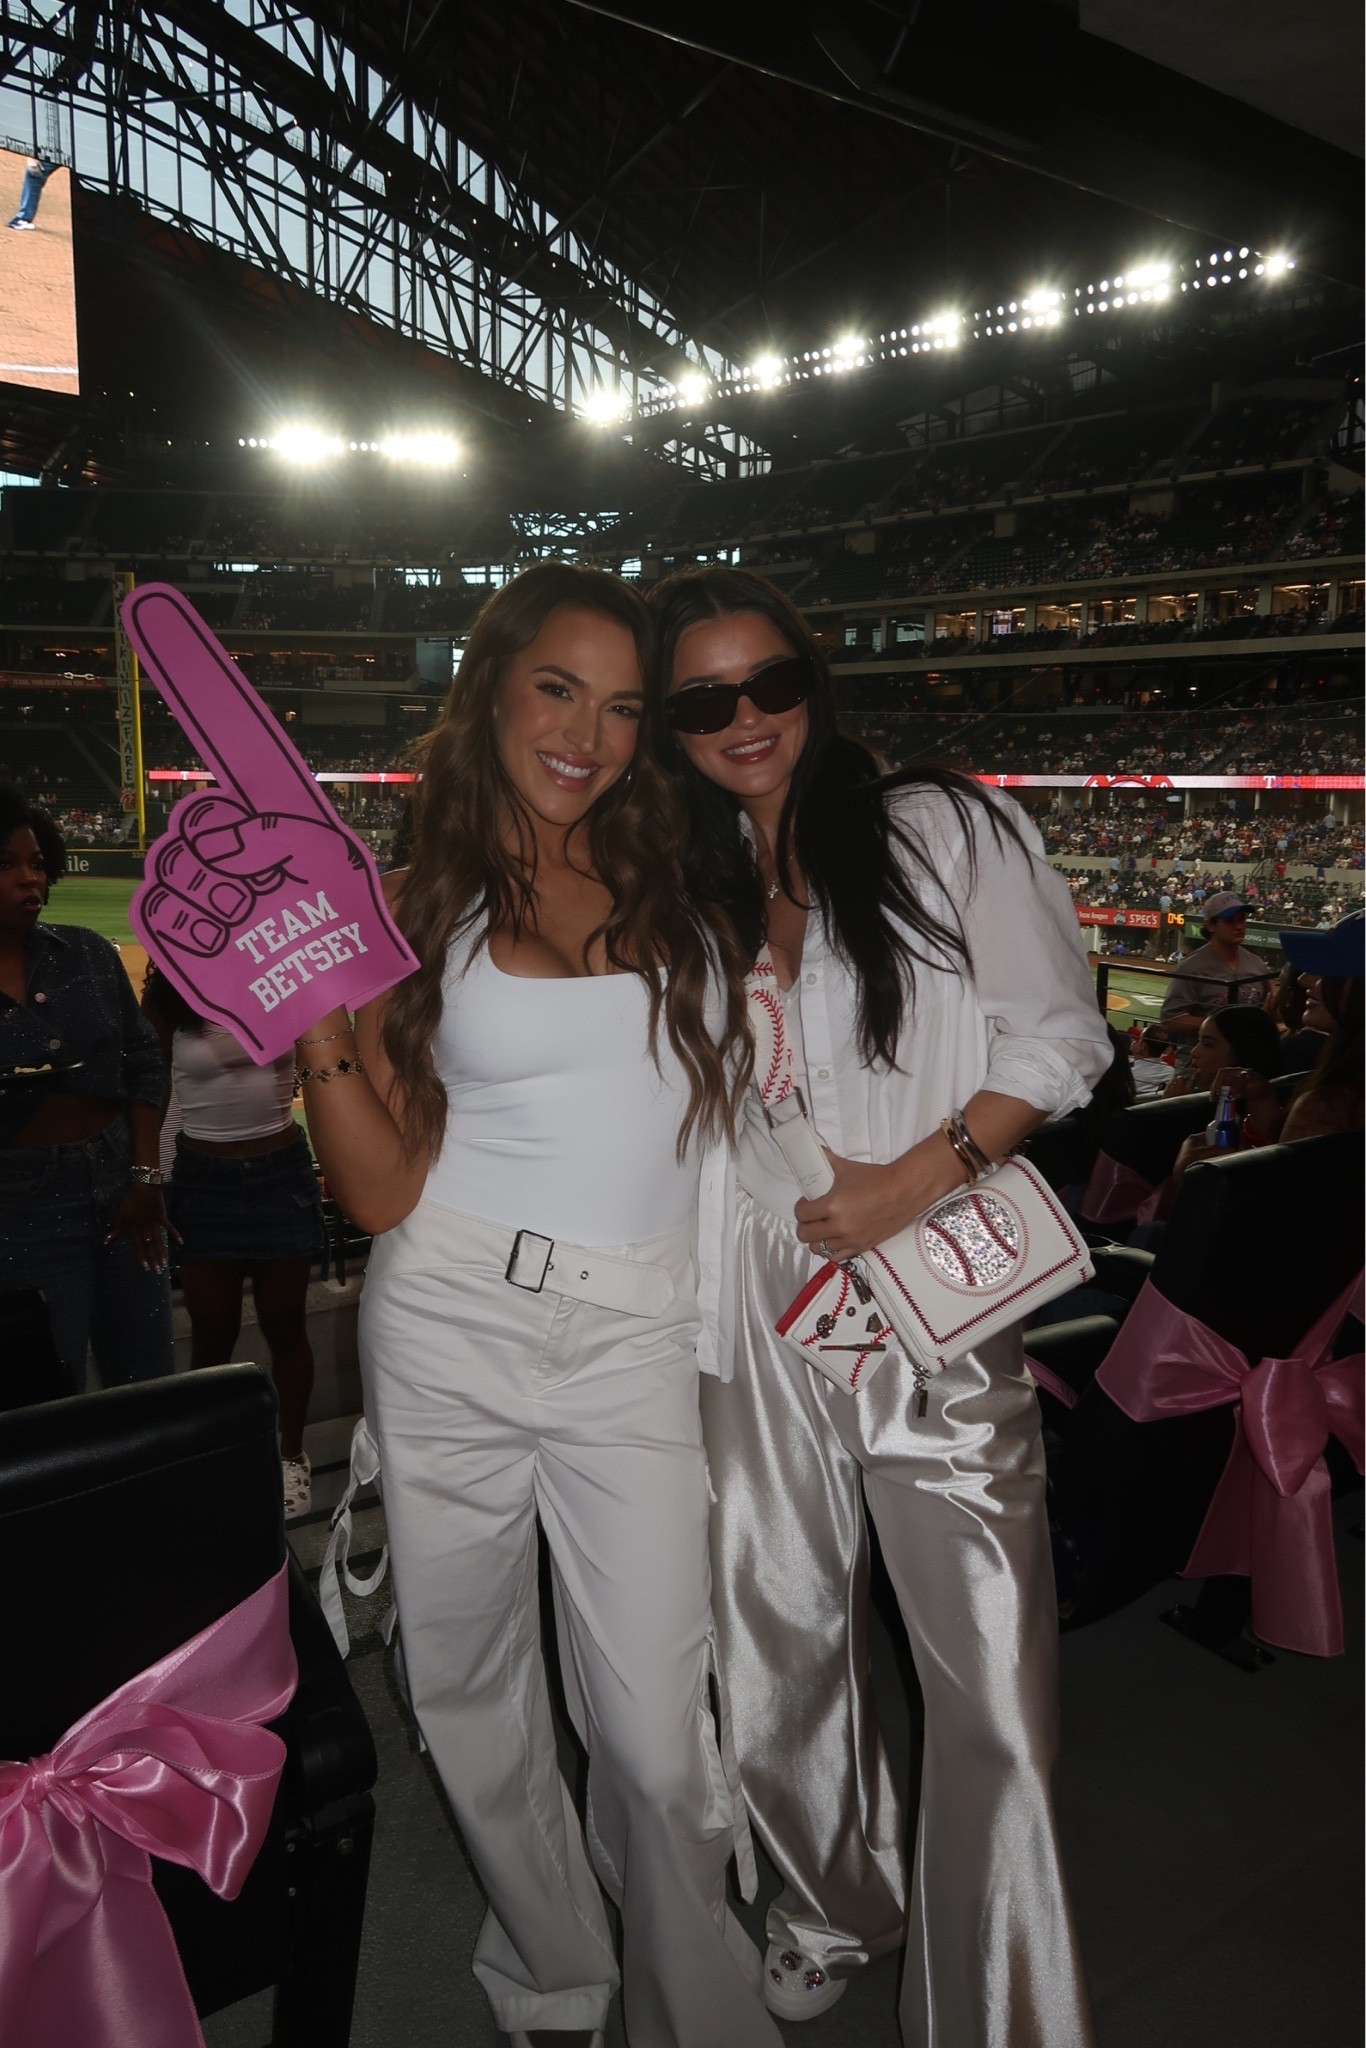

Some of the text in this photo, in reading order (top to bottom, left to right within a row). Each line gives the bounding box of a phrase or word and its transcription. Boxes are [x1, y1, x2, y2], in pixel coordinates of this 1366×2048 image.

[123, 727, 134, 781] FARE
[62, 855, 90, 872] ile
[234, 890, 339, 964] TEAM
[1129, 913, 1158, 925] SPEC'S
[248, 922, 369, 1013] BETSEY
